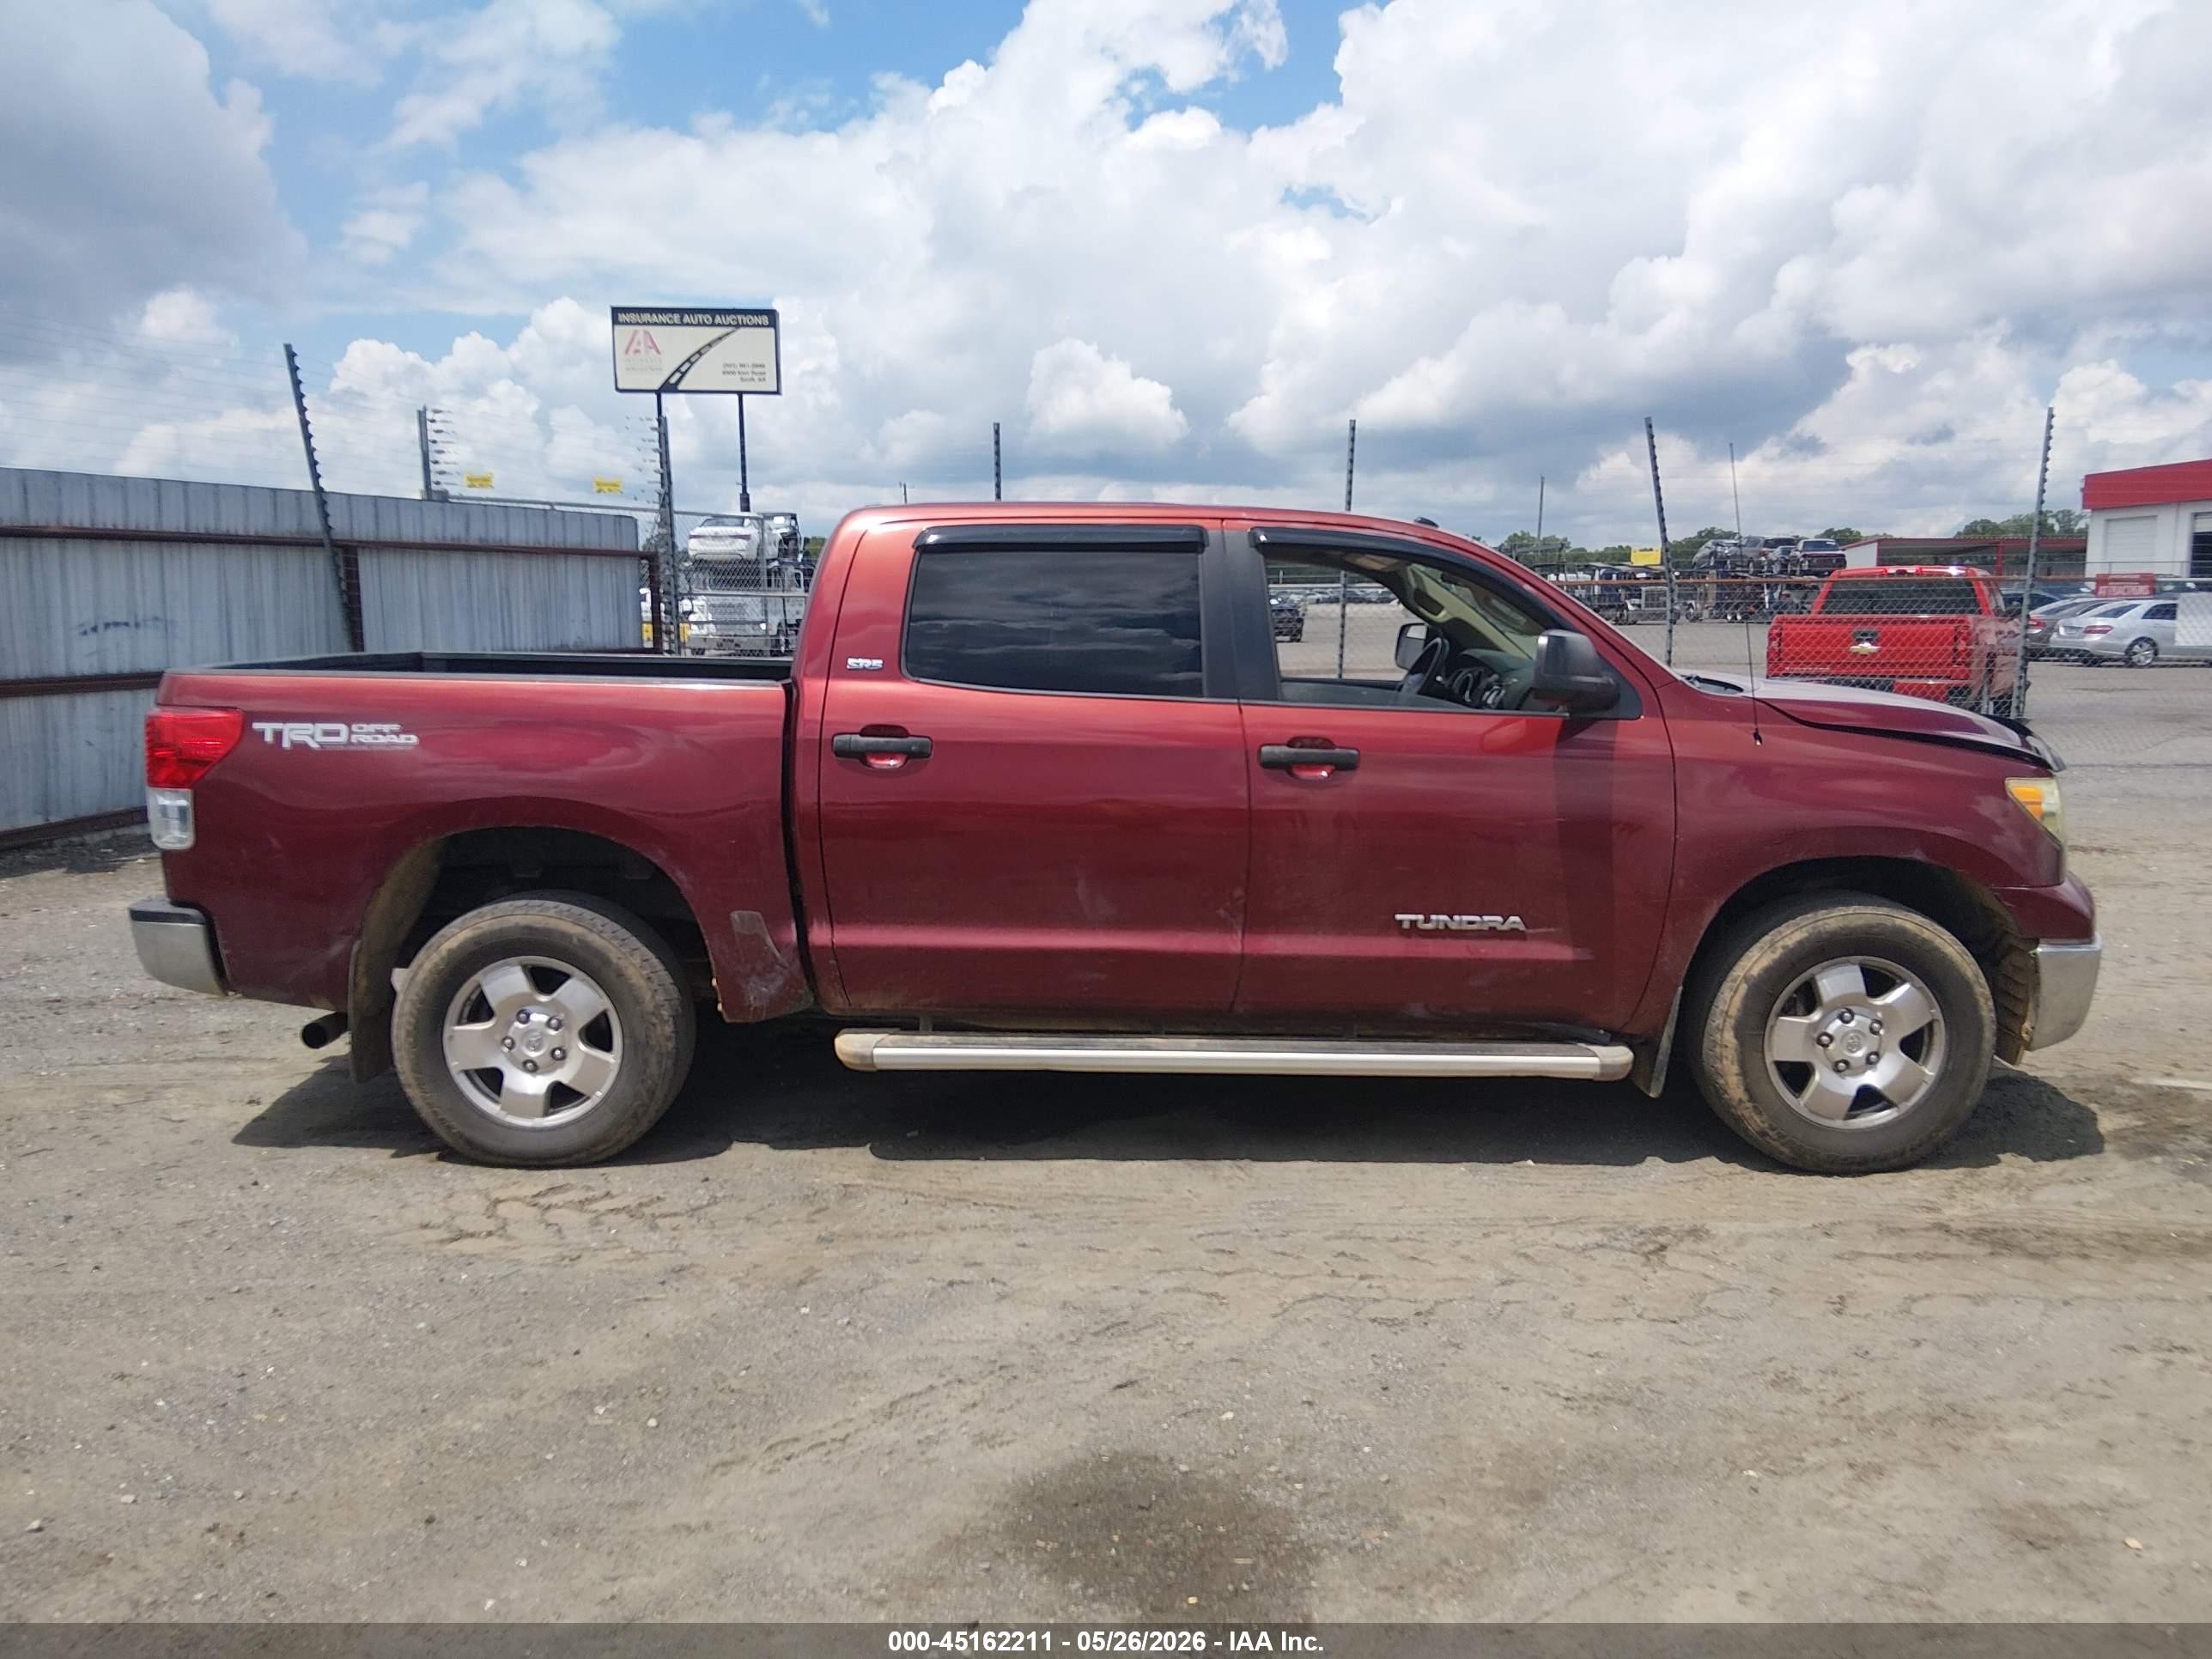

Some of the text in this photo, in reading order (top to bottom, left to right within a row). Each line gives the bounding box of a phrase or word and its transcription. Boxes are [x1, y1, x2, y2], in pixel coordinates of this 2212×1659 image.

[617, 313, 769, 325] INSURANCE AUTO AUCTIONS
[350, 723, 401, 733] OFF
[252, 722, 349, 750] TRD
[350, 734, 419, 745] ROAD
[1394, 914, 1527, 932] TUNDRA
